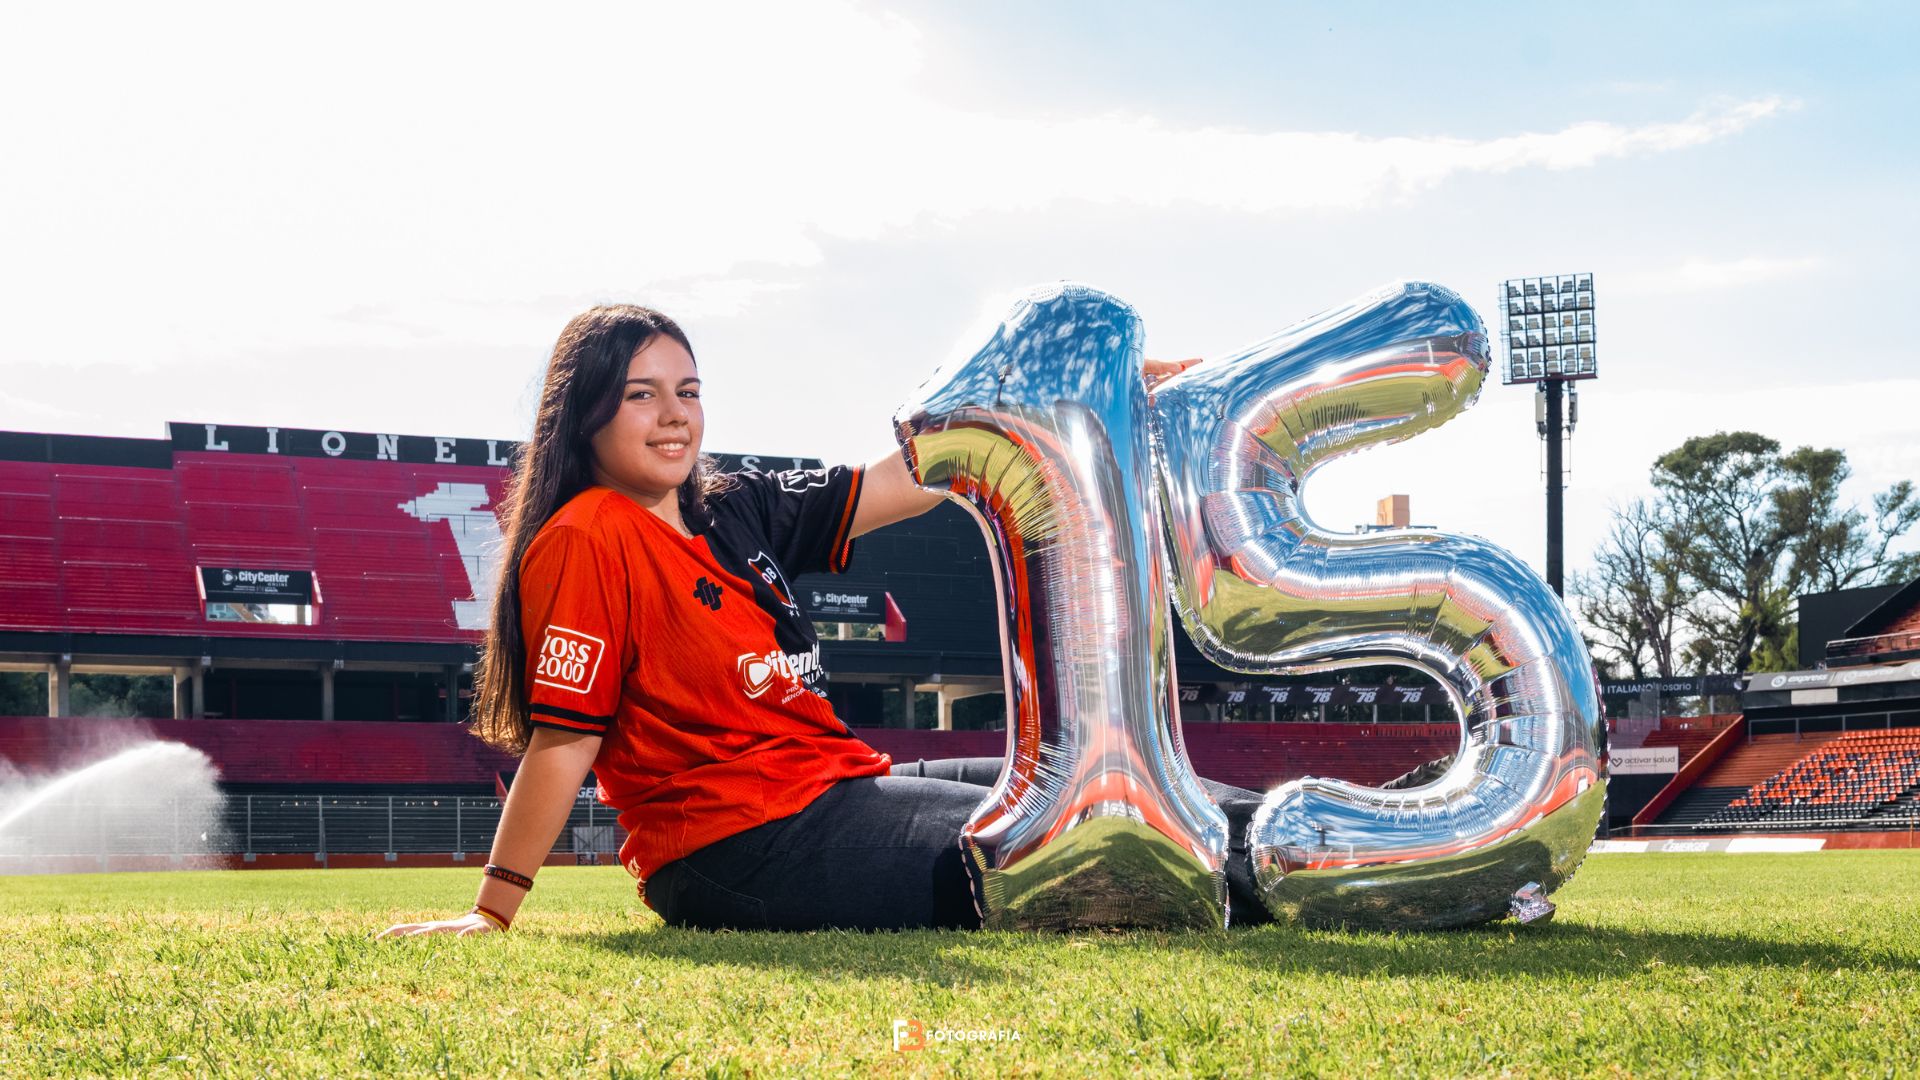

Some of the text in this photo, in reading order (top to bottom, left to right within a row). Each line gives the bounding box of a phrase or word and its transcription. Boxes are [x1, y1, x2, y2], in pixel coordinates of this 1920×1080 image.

[204, 424, 508, 466] LIONEL
[238, 571, 289, 584] CityCenter
[826, 593, 868, 605] CityCenter
[537, 654, 585, 683] 2000
[1607, 682, 1653, 694] ITALIANO
[781, 687, 806, 704] MENOR
[1180, 690, 1199, 701] 78
[1226, 691, 1246, 702] 78
[1269, 692, 1288, 702] 78
[1312, 692, 1332, 702] 78
[1357, 692, 1376, 702] 78
[1402, 692, 1421, 702] 78
[1653, 755, 1675, 763] salud
